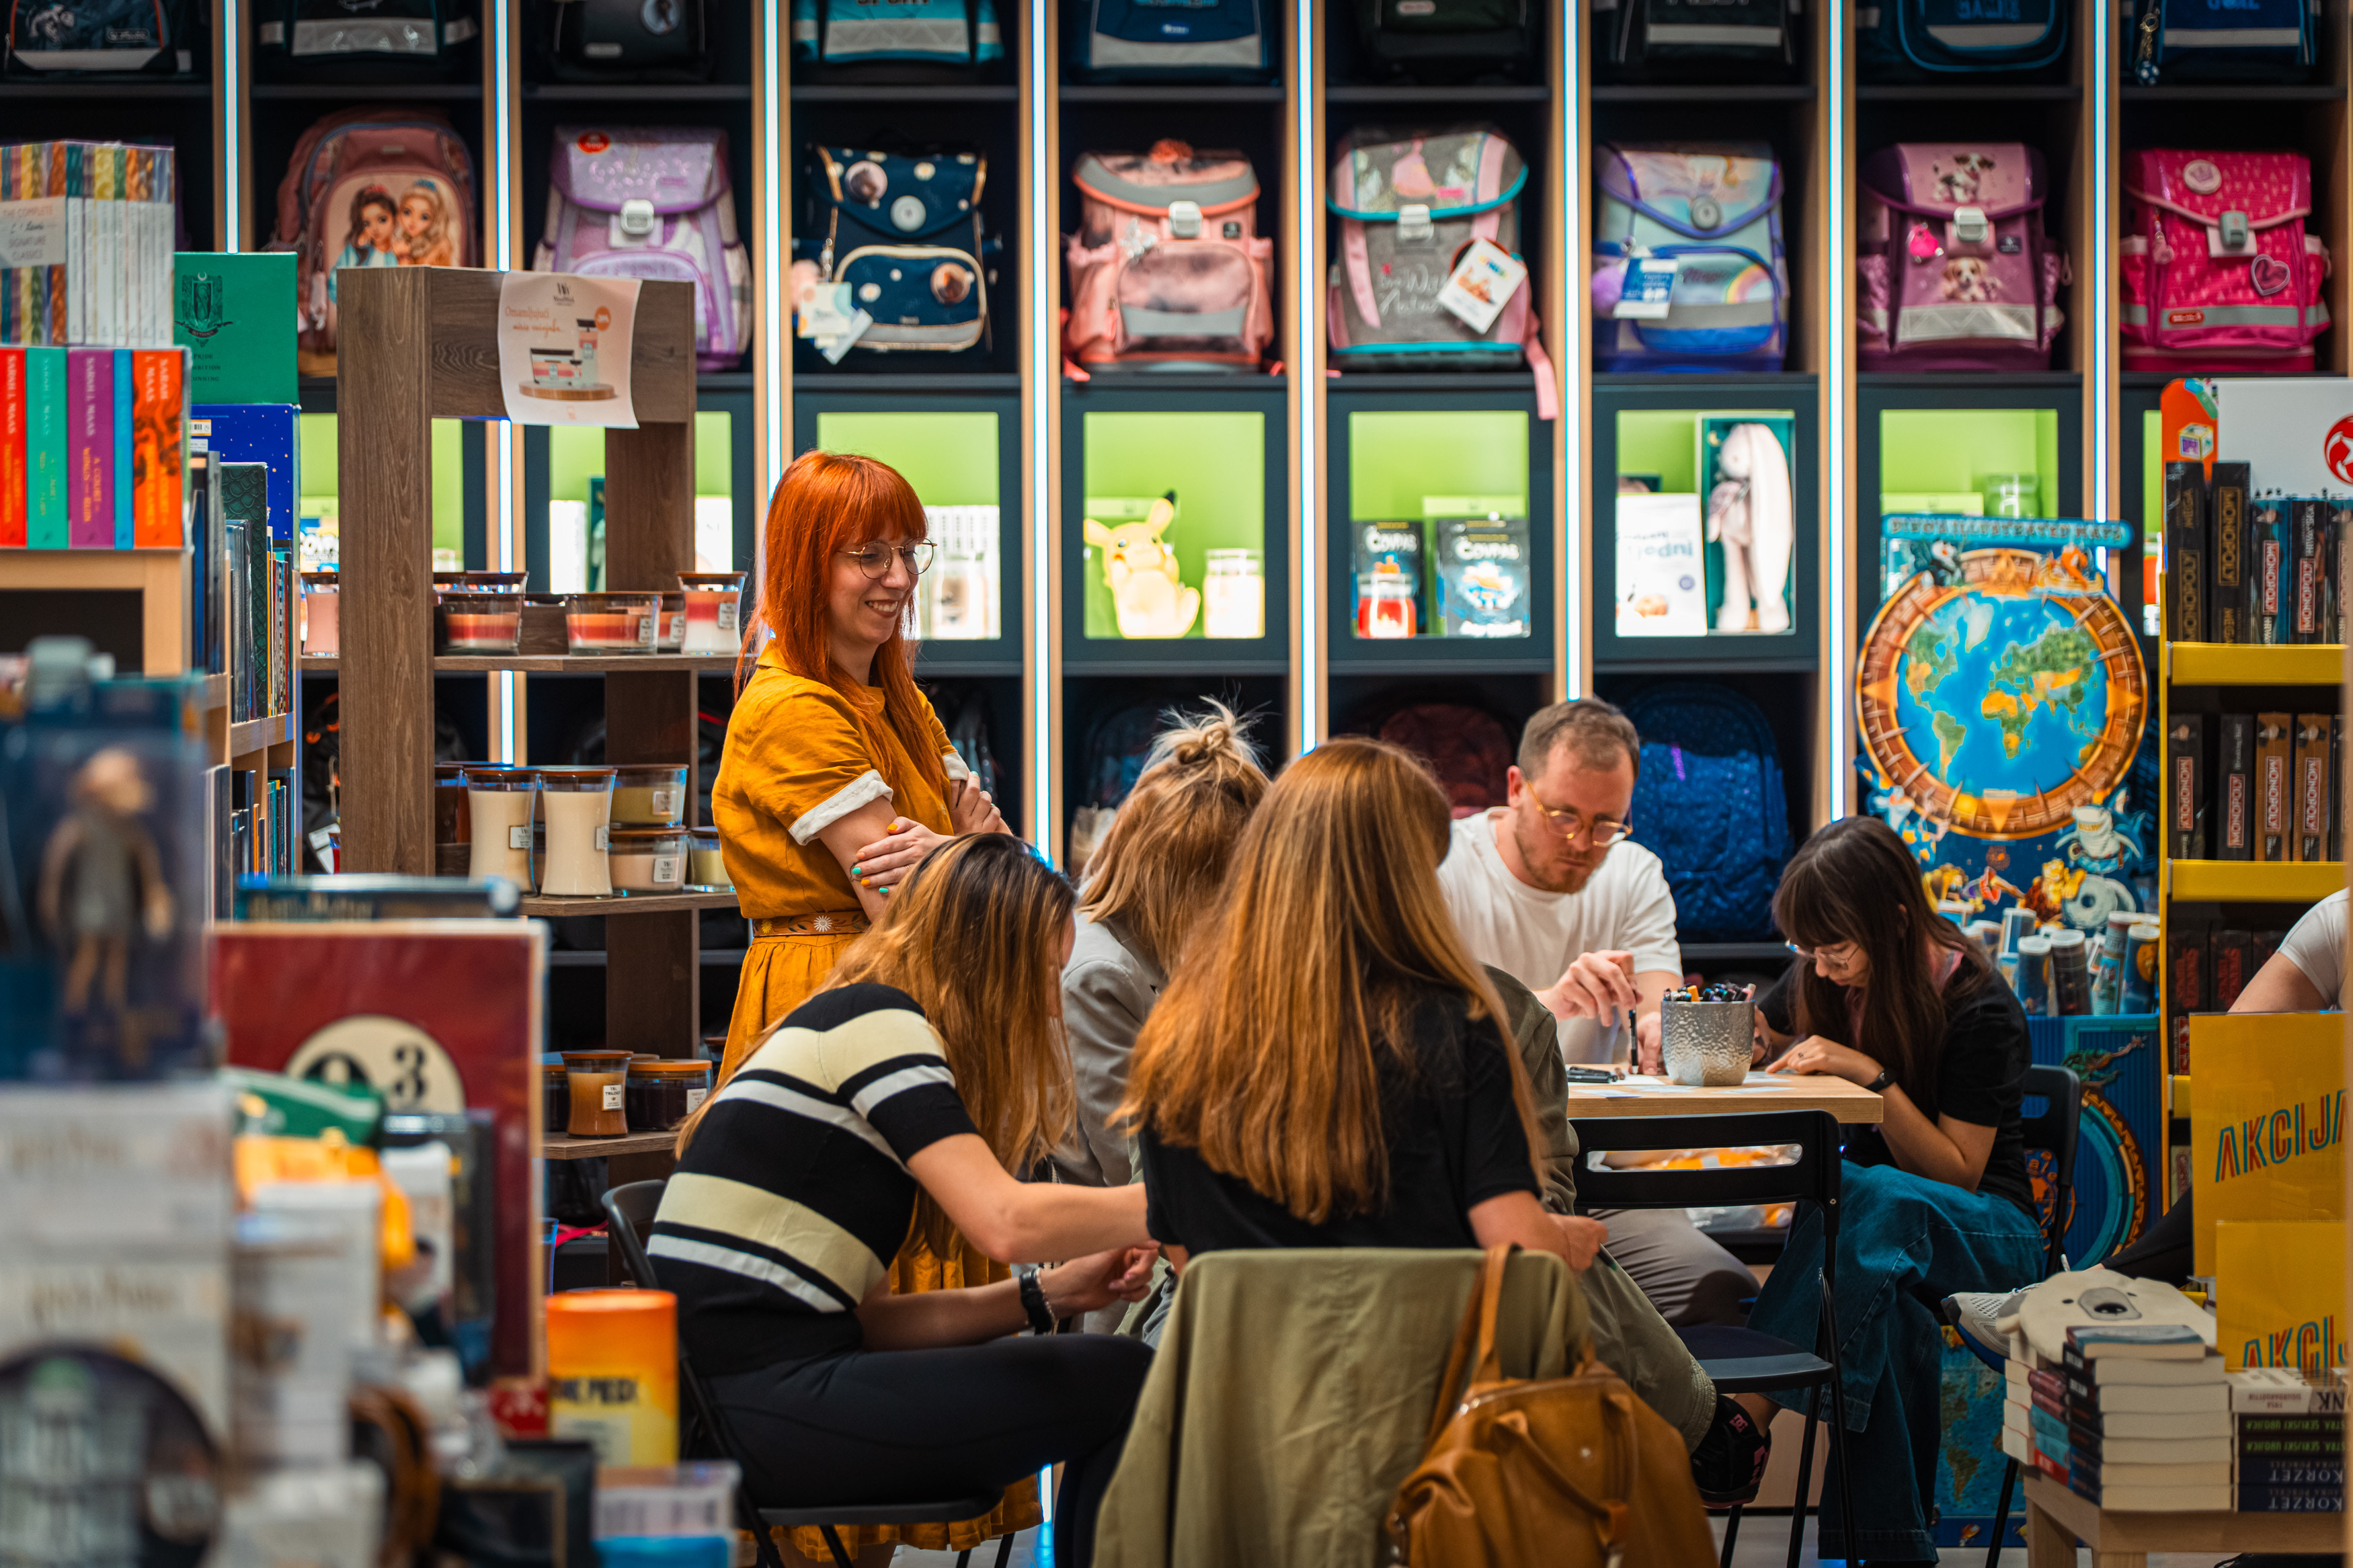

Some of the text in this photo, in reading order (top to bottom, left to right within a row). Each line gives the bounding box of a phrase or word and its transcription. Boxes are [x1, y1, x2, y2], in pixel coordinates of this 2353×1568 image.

[2223, 490, 2236, 582] MONOPOLY
[2265, 544, 2278, 611] MONOPOLY
[2301, 562, 2314, 631] MONOPOLY
[2179, 758, 2190, 827] MONOPOLY
[2230, 776, 2243, 844] MONOPOLY
[2267, 759, 2279, 828] MONOPOLY
[2306, 759, 2318, 829] MONOPOLY
[2284, 1419, 2319, 1430] SERIJSKI
[2284, 1442, 2319, 1452] SERIJSKI
[2268, 1497, 2342, 1511] KORZET
[2269, 1469, 2343, 1483] KORZET
